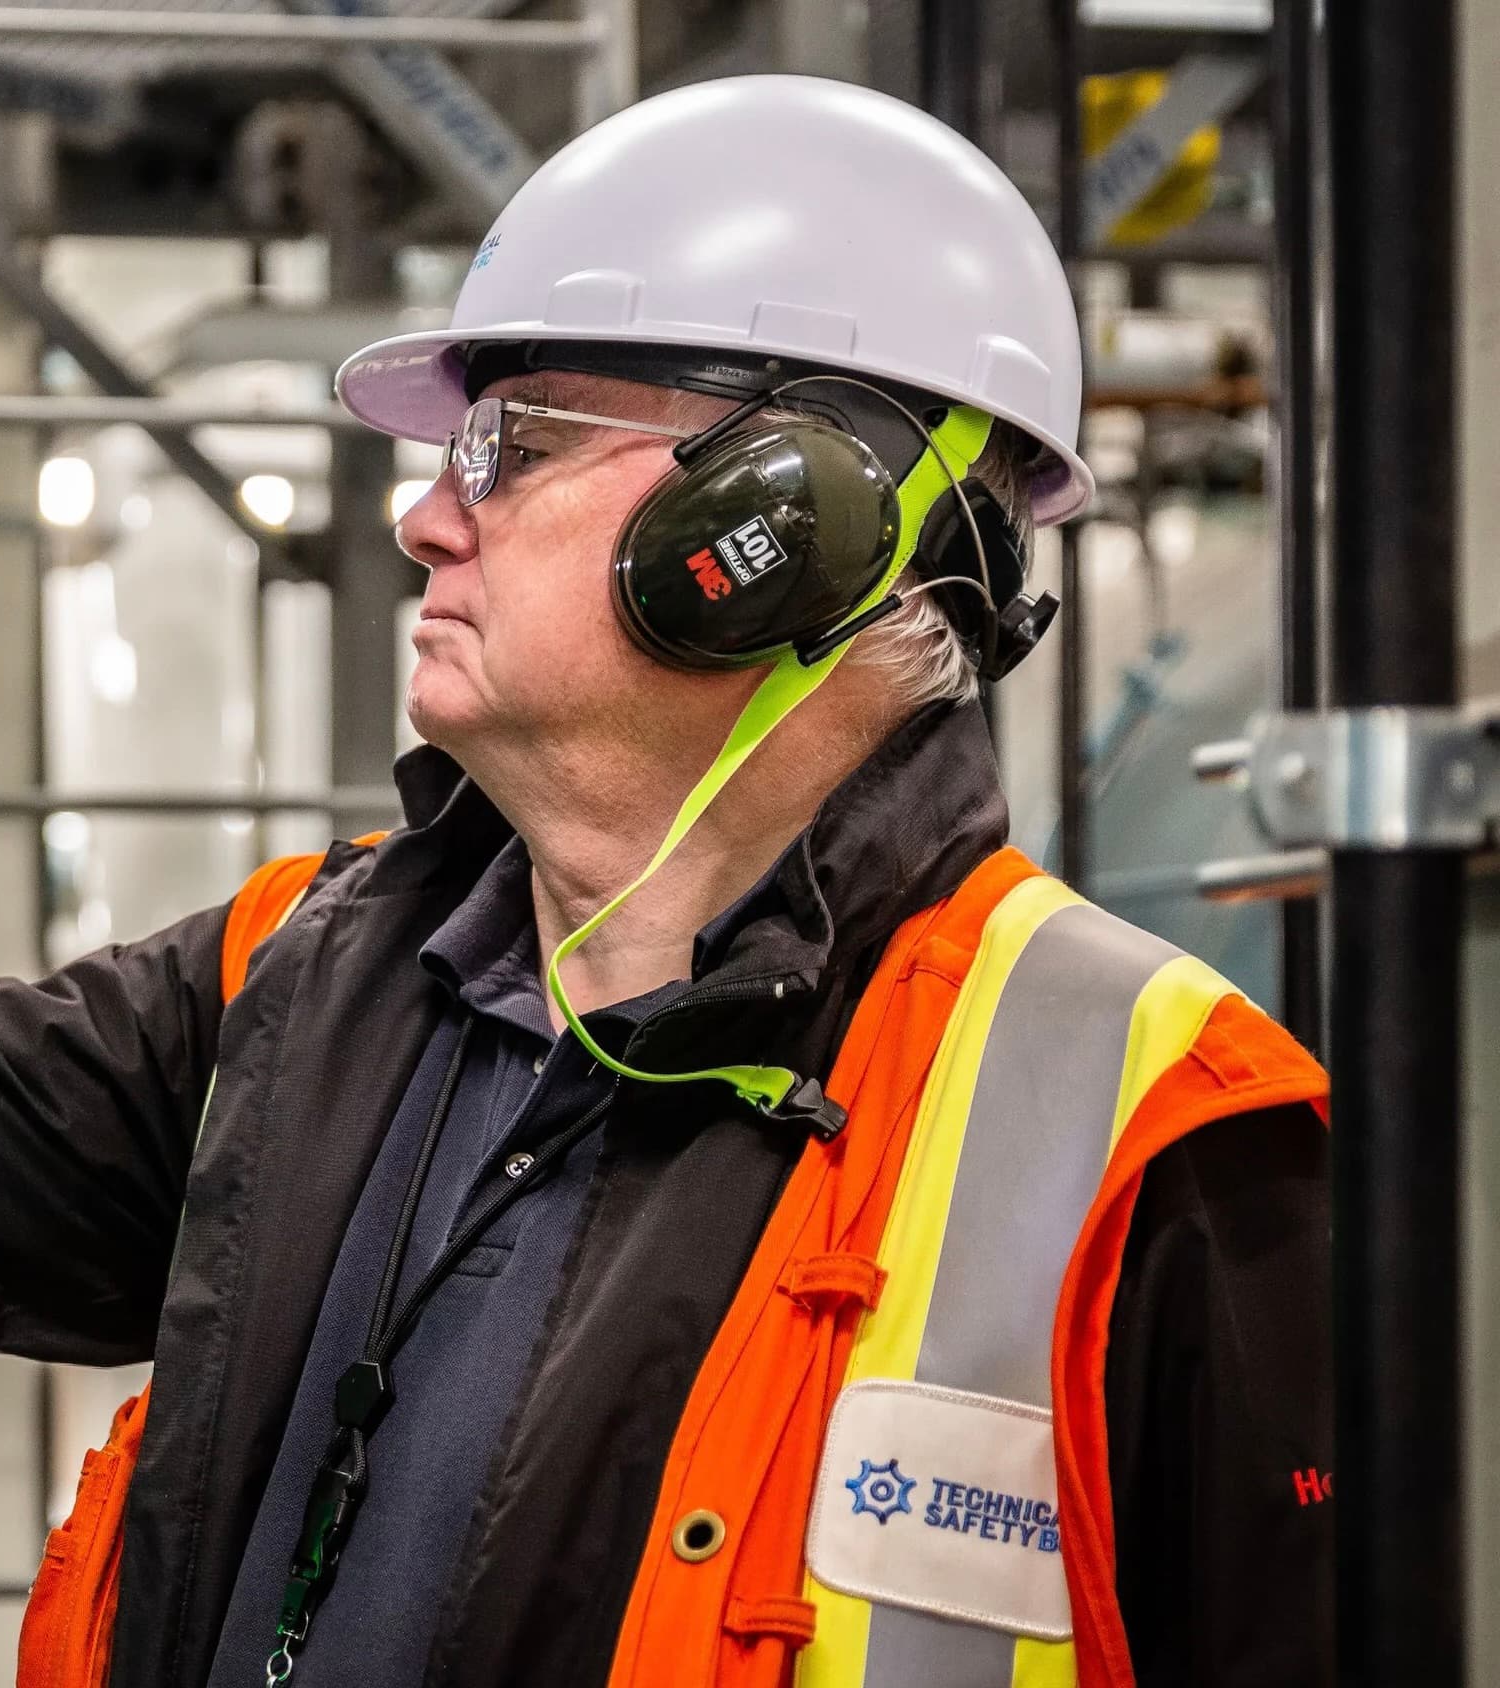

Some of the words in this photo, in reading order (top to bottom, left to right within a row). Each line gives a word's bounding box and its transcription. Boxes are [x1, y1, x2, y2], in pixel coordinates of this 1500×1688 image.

[720, 539, 751, 582] OPTIME
[735, 521, 777, 570] 101
[686, 547, 732, 600] 3M
